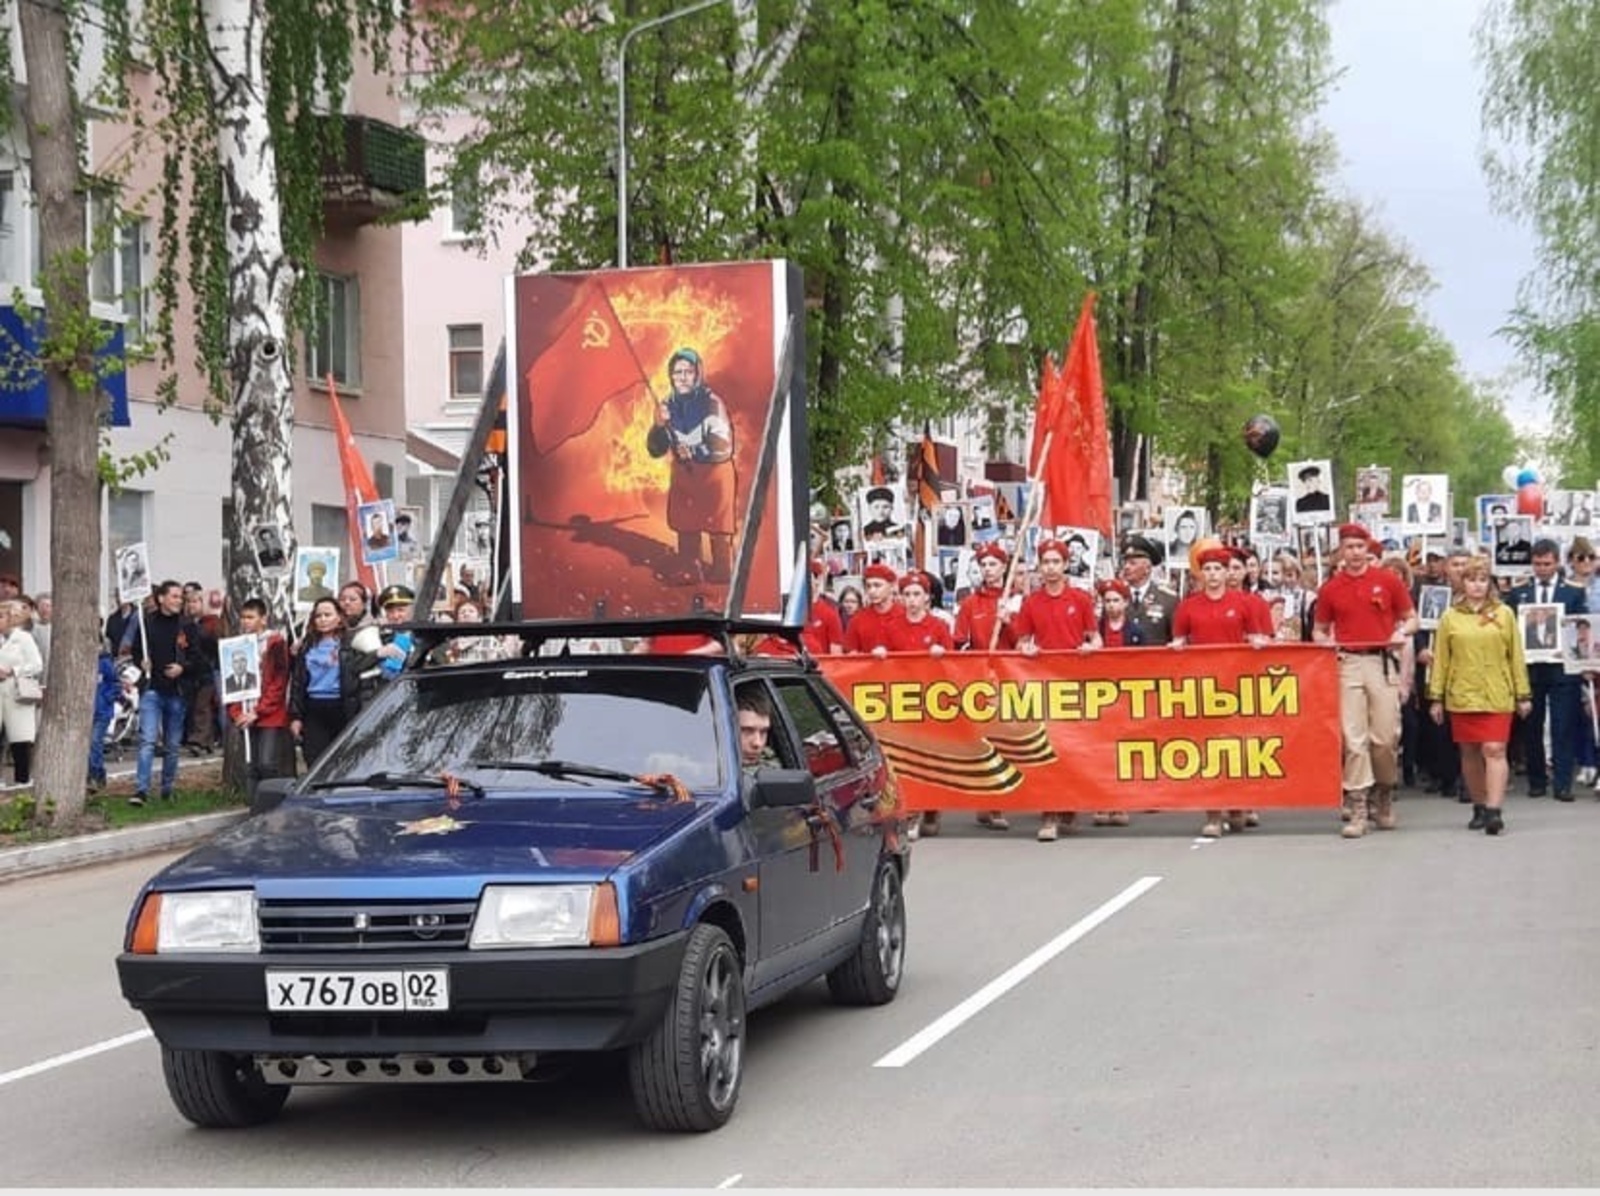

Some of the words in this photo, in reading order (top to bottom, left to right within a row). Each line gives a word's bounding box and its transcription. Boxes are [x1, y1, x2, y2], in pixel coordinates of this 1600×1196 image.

[852, 666, 1299, 721] БЕССМЕРТНЫЙ
[1117, 737, 1283, 781] ПОЛК
[408, 974, 437, 997] 02
